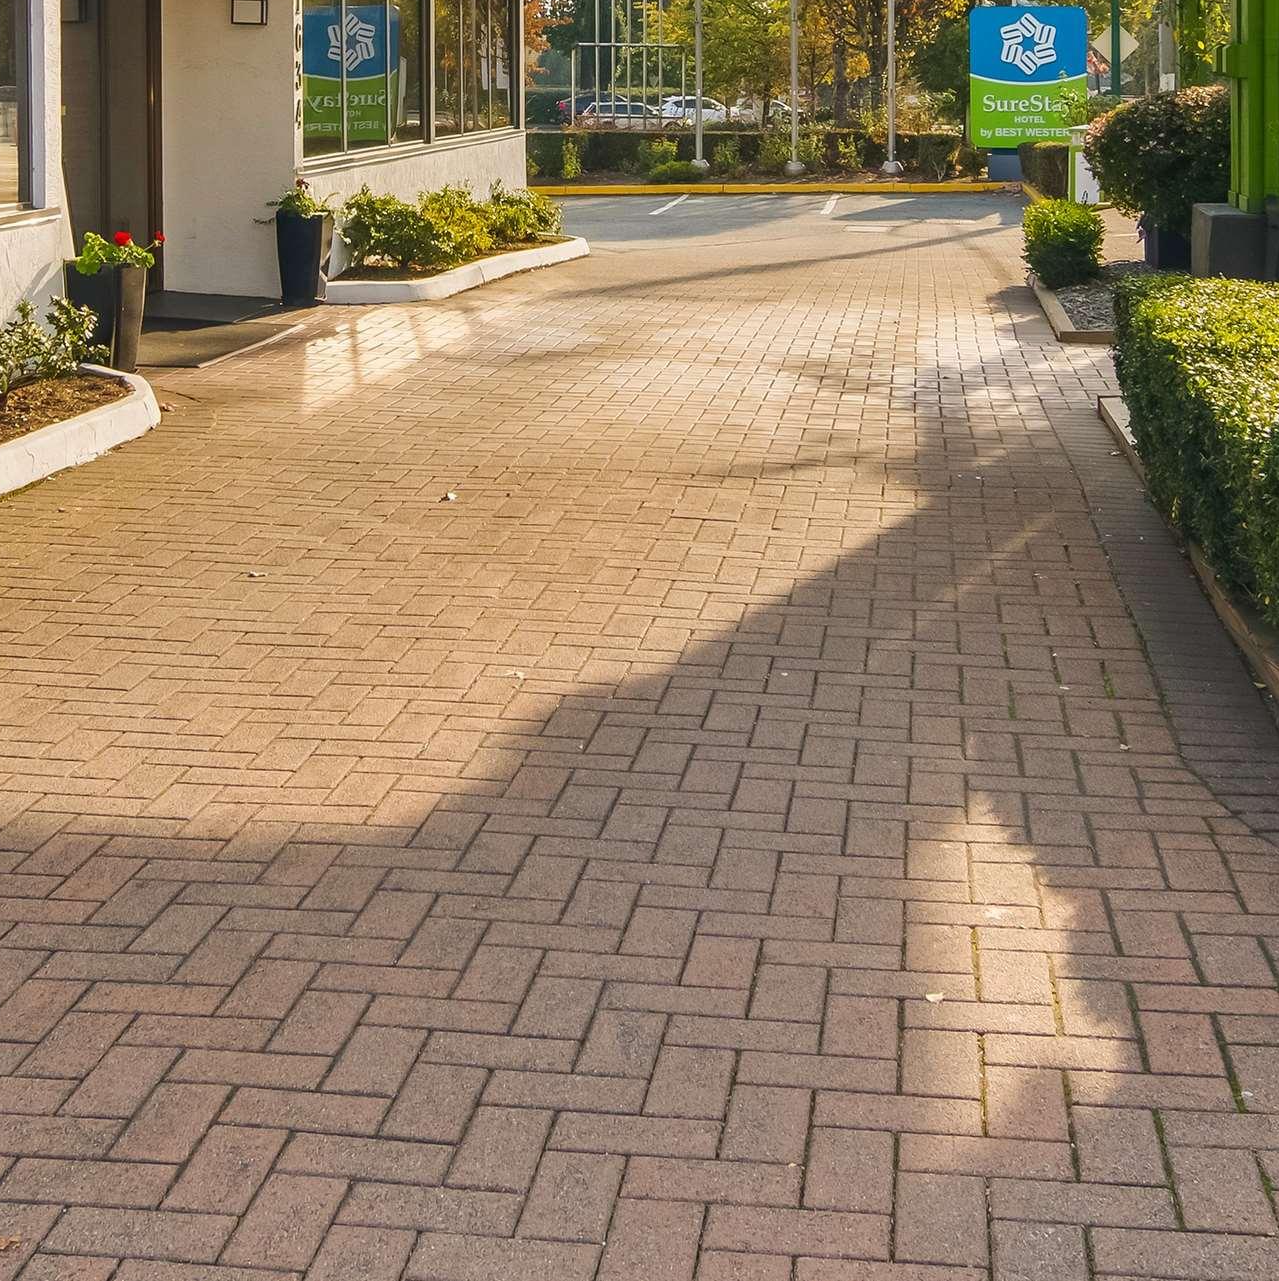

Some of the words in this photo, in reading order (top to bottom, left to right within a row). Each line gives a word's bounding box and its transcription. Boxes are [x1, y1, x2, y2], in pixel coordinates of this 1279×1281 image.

[980, 128, 992, 138] by
[996, 128, 1022, 137] BEST
[1025, 128, 1072, 137] WESTER
